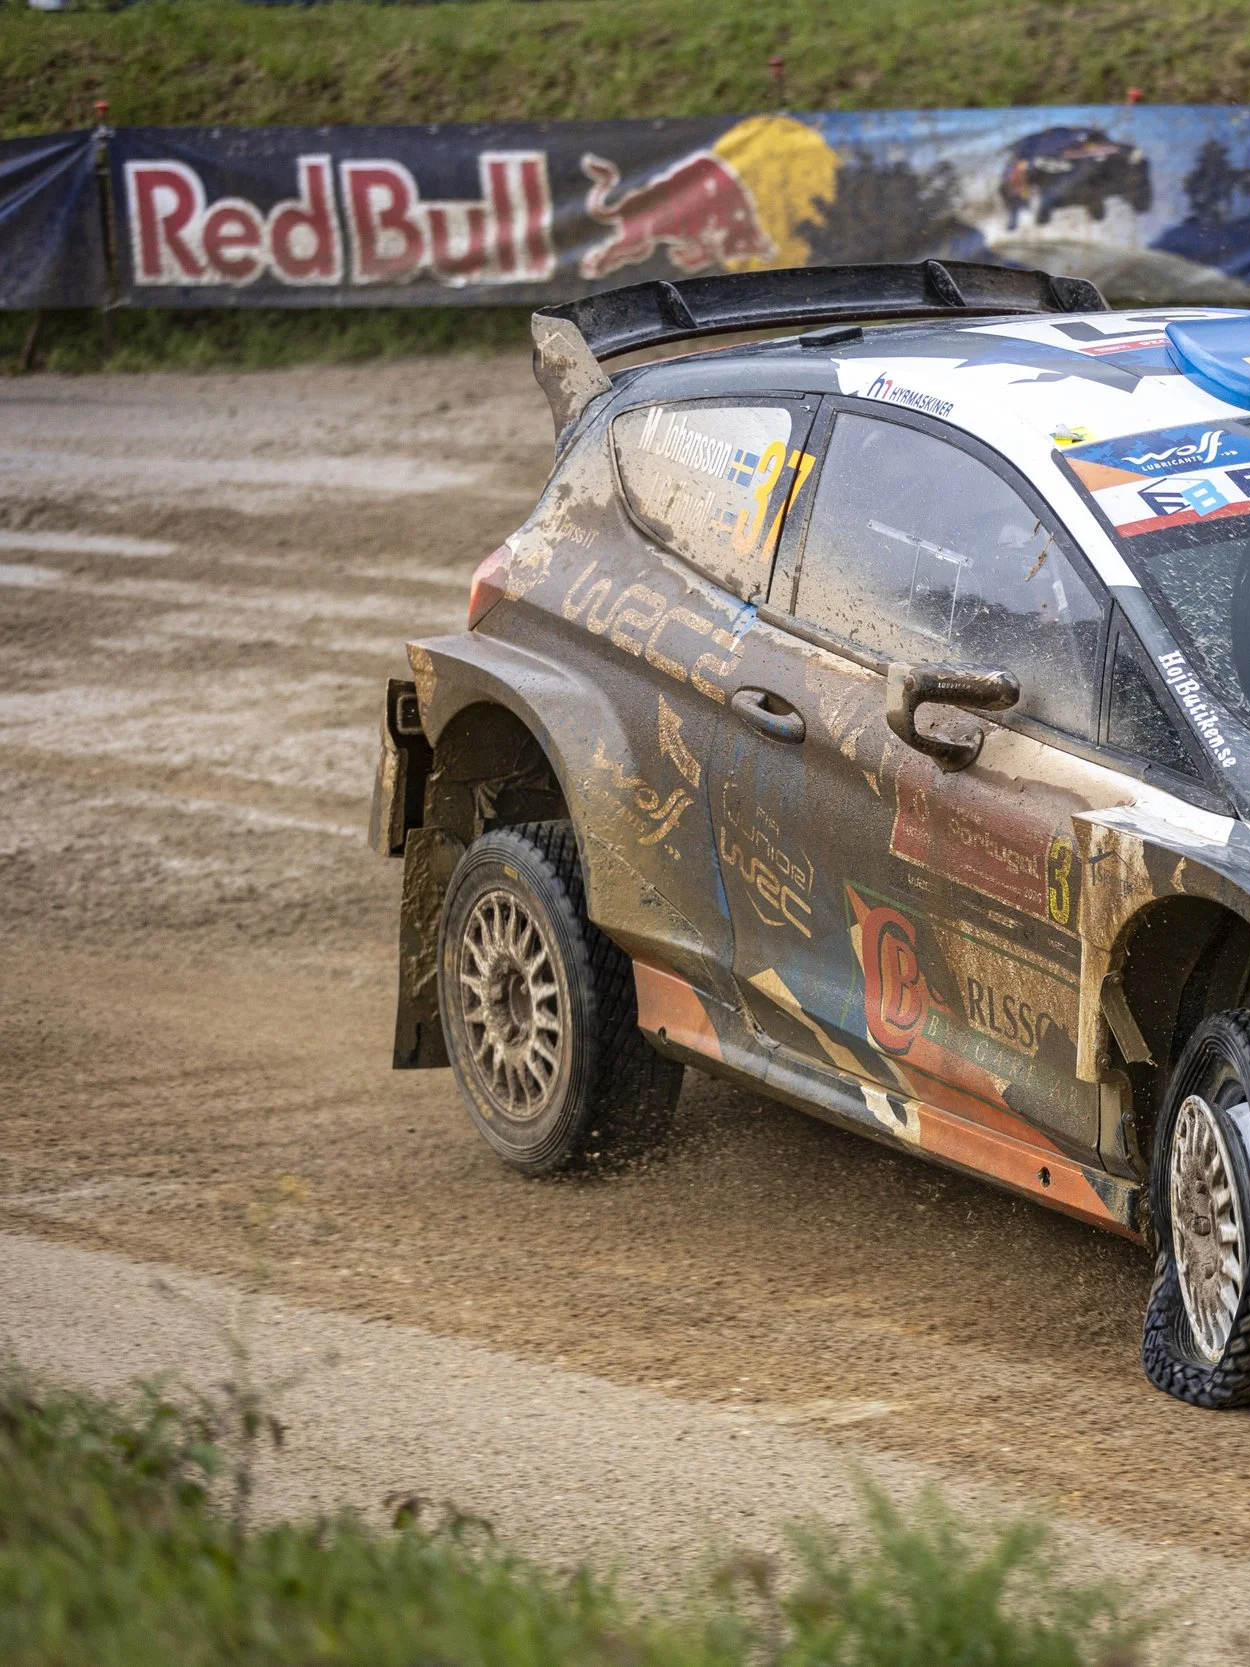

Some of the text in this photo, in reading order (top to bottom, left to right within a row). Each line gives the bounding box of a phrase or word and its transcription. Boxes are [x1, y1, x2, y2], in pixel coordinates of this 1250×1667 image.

[125, 150, 557, 288] Red Bull
[889, 386, 955, 417] HYRMASKINER
[638, 406, 733, 479] M Johansson
[1141, 456, 1204, 472] LUBRICANTS
[731, 440, 817, 563] 37
